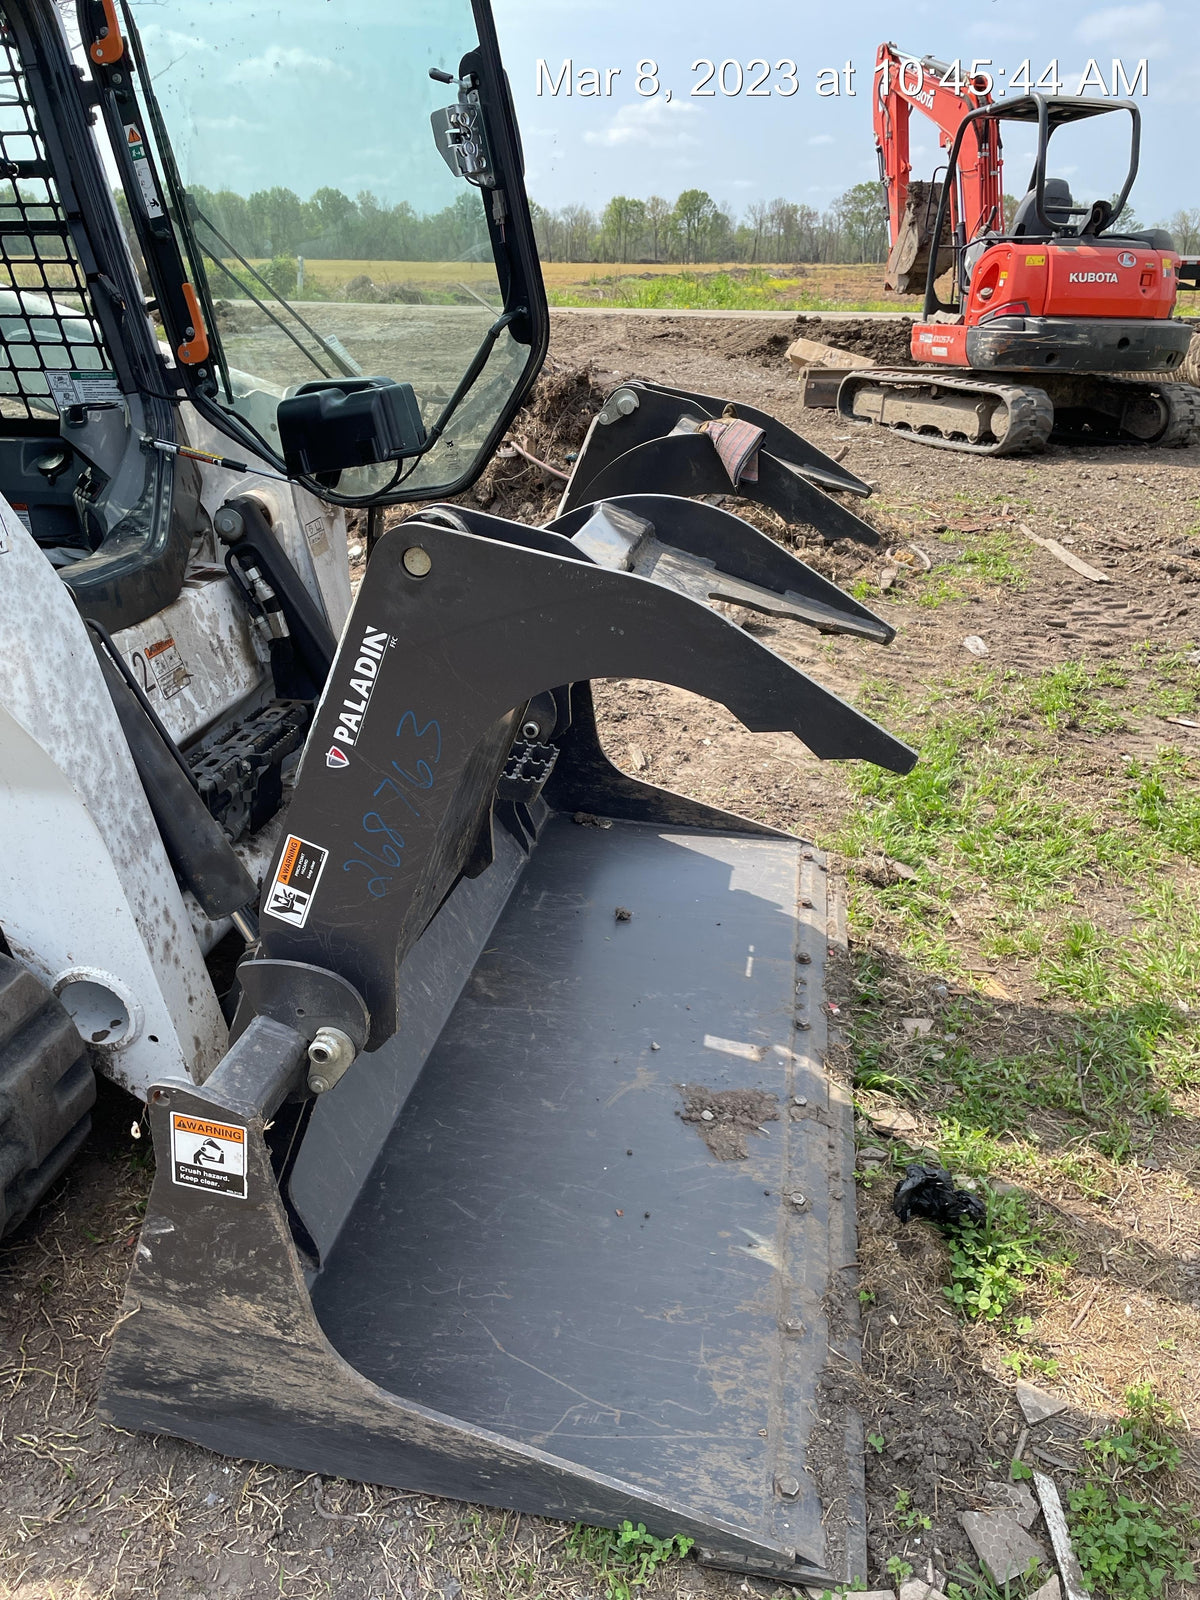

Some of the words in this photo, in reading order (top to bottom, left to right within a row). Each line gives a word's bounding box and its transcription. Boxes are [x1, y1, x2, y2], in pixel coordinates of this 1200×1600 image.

[1069, 272, 1119, 283] KUBOTA
[333, 625, 388, 746] PALADIN
[343, 710, 442, 898] 268763
[284, 842, 297, 874] WARNING
[186, 1121, 242, 1140] WARNING
[180, 1165, 202, 1176] Crush
[203, 1170, 230, 1182] hazard.
[180, 1173, 199, 1184] Keep
[200, 1178, 220, 1188] clear.
